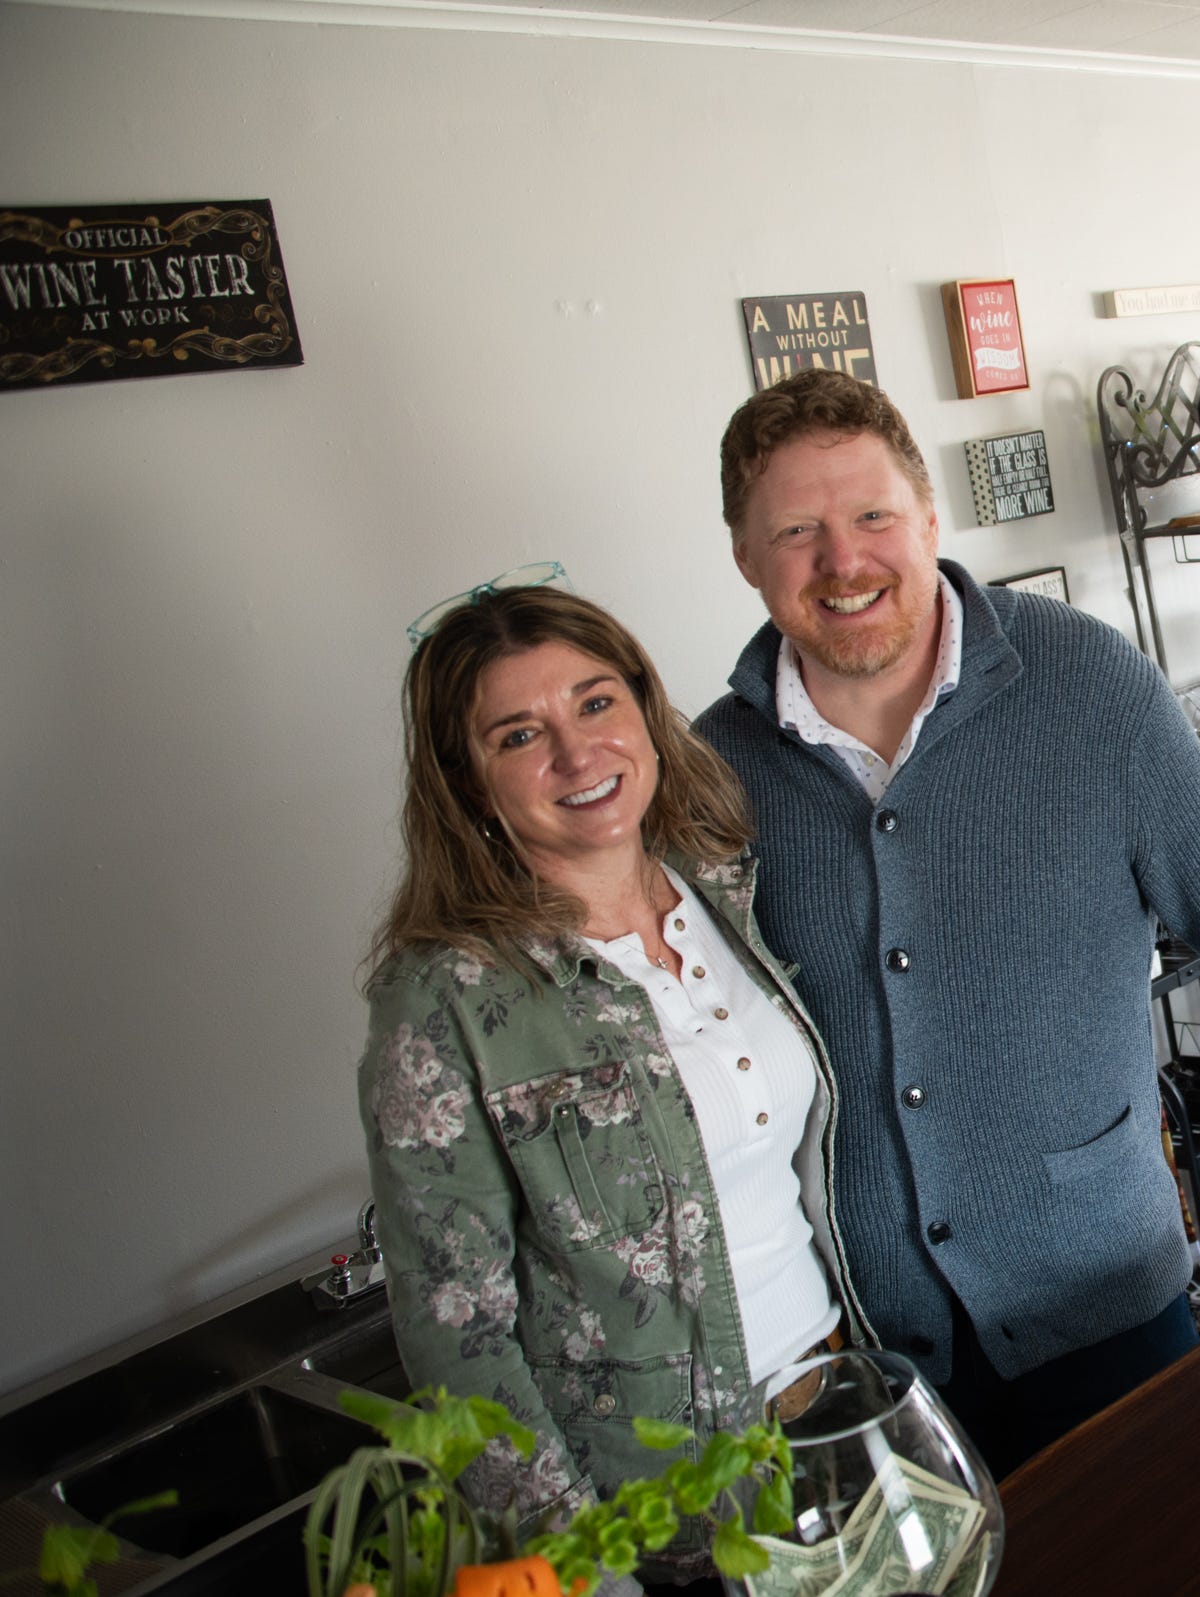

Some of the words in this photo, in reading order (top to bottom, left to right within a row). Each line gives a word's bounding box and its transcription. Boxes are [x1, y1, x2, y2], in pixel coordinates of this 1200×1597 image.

[65, 227, 168, 249] OFFICIAL
[0, 260, 107, 310] WINE
[114, 253, 255, 302] TASTER
[976, 291, 1003, 306] WHEN
[82, 312, 110, 331] AT
[118, 306, 191, 327] WORK
[753, 305, 771, 333] A
[786, 299, 866, 330] MEAL
[970, 310, 1014, 333] wine
[776, 330, 848, 351] WITHOUT
[986, 441, 993, 457] IT
[1020, 432, 1044, 451] MATTER
[988, 457, 996, 475] IF
[998, 455, 1013, 473] THE
[1014, 450, 1037, 470] GLASS
[1038, 448, 1047, 466] IS
[995, 493, 1024, 521] MORE
[1023, 487, 1053, 514] WINE.
